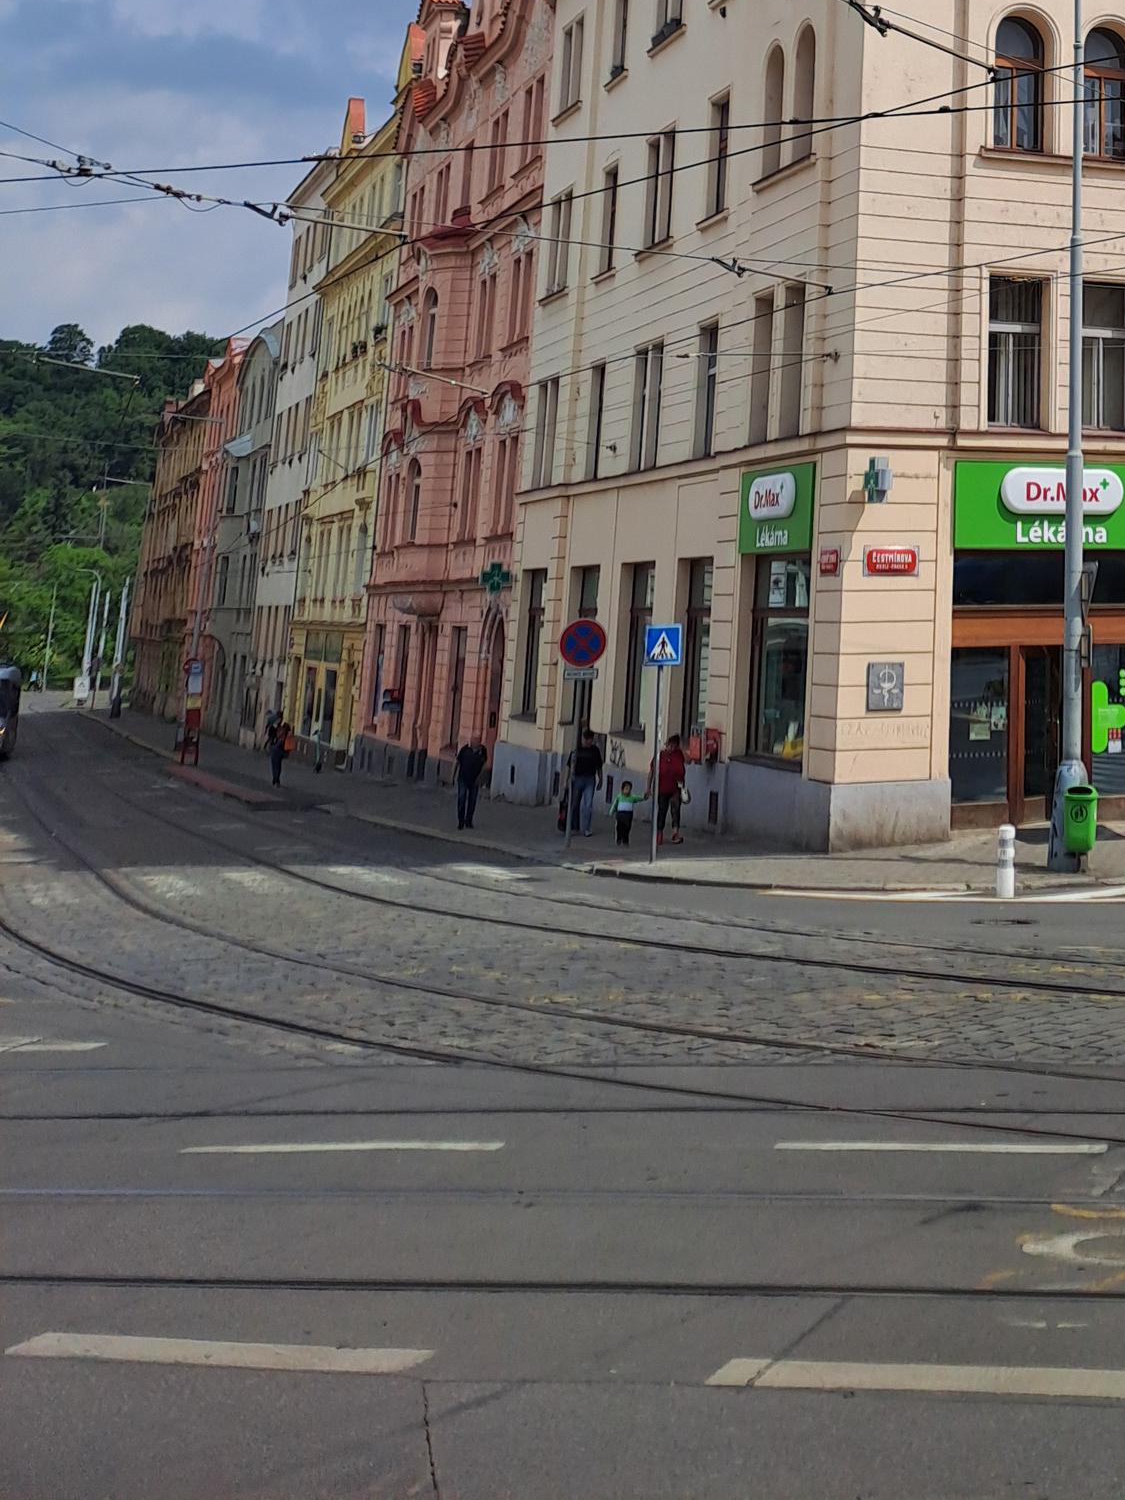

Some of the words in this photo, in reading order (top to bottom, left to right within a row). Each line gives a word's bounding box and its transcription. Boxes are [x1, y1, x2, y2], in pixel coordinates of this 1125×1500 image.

[753, 488, 780, 510] Dr.Max
[755, 524, 789, 548] Lékárna
[1016, 519, 1108, 544] Lékána
